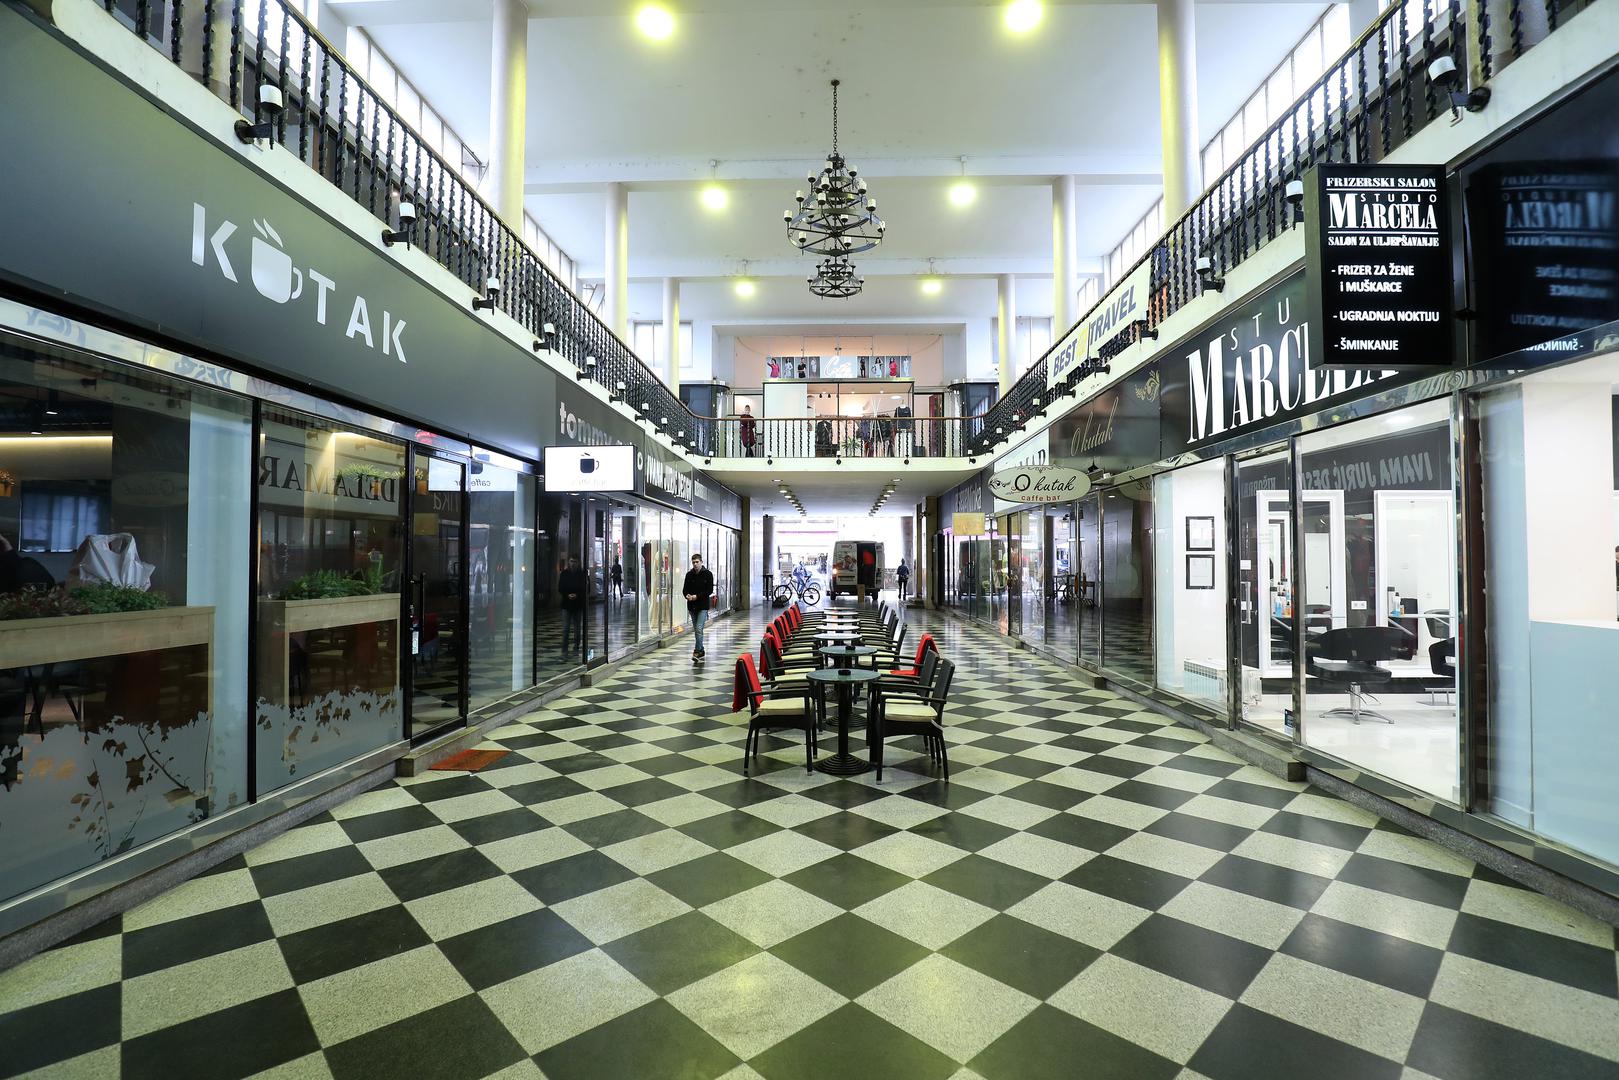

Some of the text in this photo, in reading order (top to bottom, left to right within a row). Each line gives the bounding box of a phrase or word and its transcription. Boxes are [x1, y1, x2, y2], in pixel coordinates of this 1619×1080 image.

[1326, 177, 1436, 188] FRIZERSKI SALON
[1360, 193, 1437, 203] STUDIO
[1327, 193, 1438, 229] MARCELA
[1328, 234, 1440, 247] SALON ZA ULJEPŠAVANJE
[1337, 265, 1372, 275] FRIZER
[1373, 265, 1387, 276] ZA
[1389, 262, 1415, 276] ŽENE
[1345, 279, 1402, 292] MUŠKARCE
[1339, 310, 1396, 321] UGRADNJA
[1053, 284, 1137, 378] BEST TRAVEL
[1230, 297, 1290, 351] STU
[1340, 337, 1399, 351] ŠMINKANJE
[1034, 475, 1077, 492] kutak
